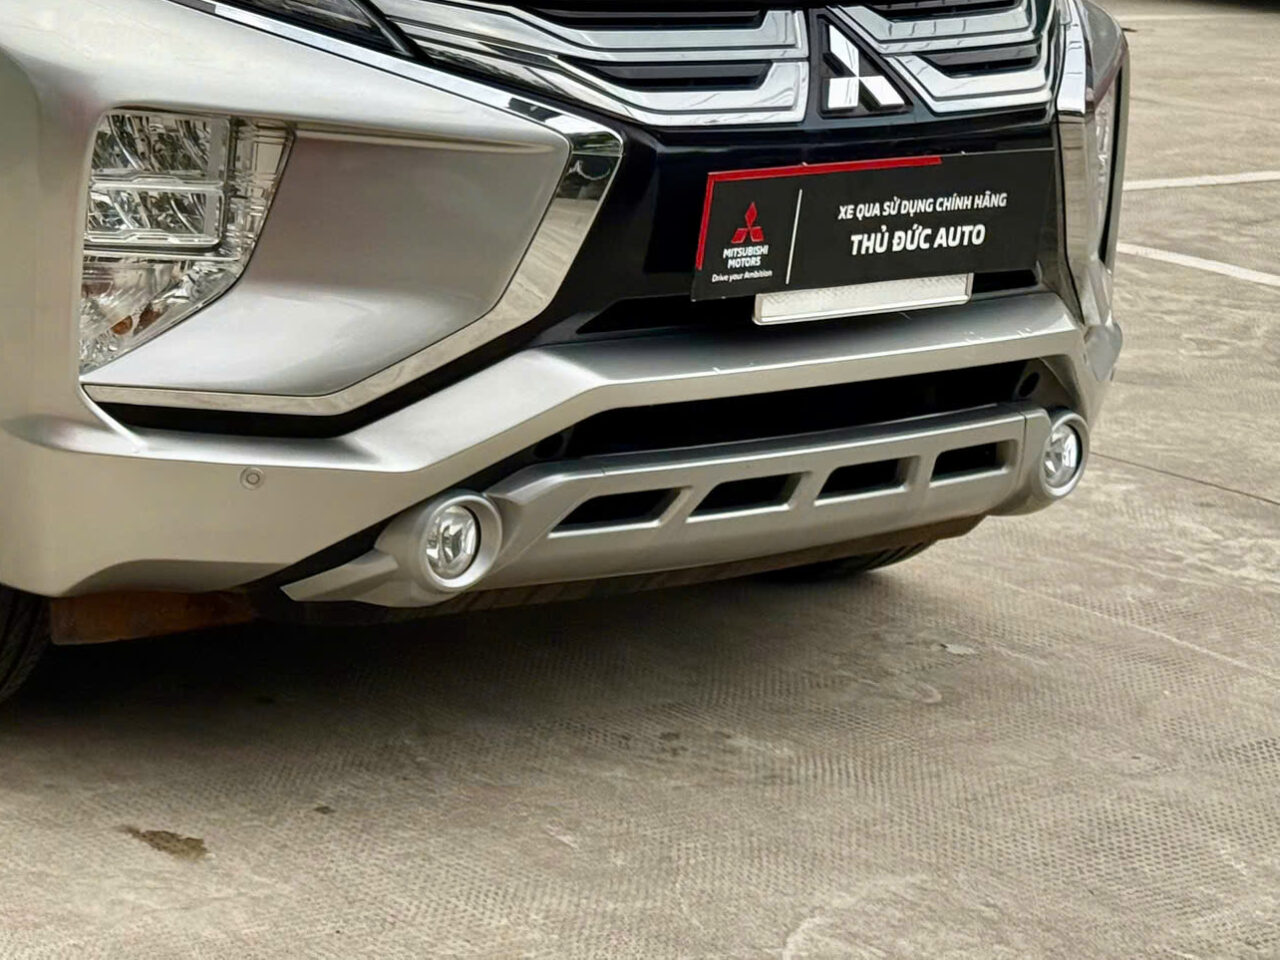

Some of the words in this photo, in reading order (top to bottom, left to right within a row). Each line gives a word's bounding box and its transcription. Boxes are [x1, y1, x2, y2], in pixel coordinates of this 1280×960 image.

[838, 205, 854, 220] XE
[856, 202, 880, 221] QUA
[882, 196, 901, 216] SỬ
[900, 198, 934, 217] DỤNG
[936, 193, 972, 212] CHÍNH
[974, 191, 1008, 209] HÃNG
[850, 225, 889, 256] THỦ
[892, 224, 932, 251] ĐỨC
[934, 224, 986, 248] AUTO
[723, 244, 769, 259] MITSUBISHI
[728, 256, 761, 269] MOTORS
[712, 273, 729, 283] Drive
[729, 272, 743, 283] your
[744, 269, 773, 279] Ambition
